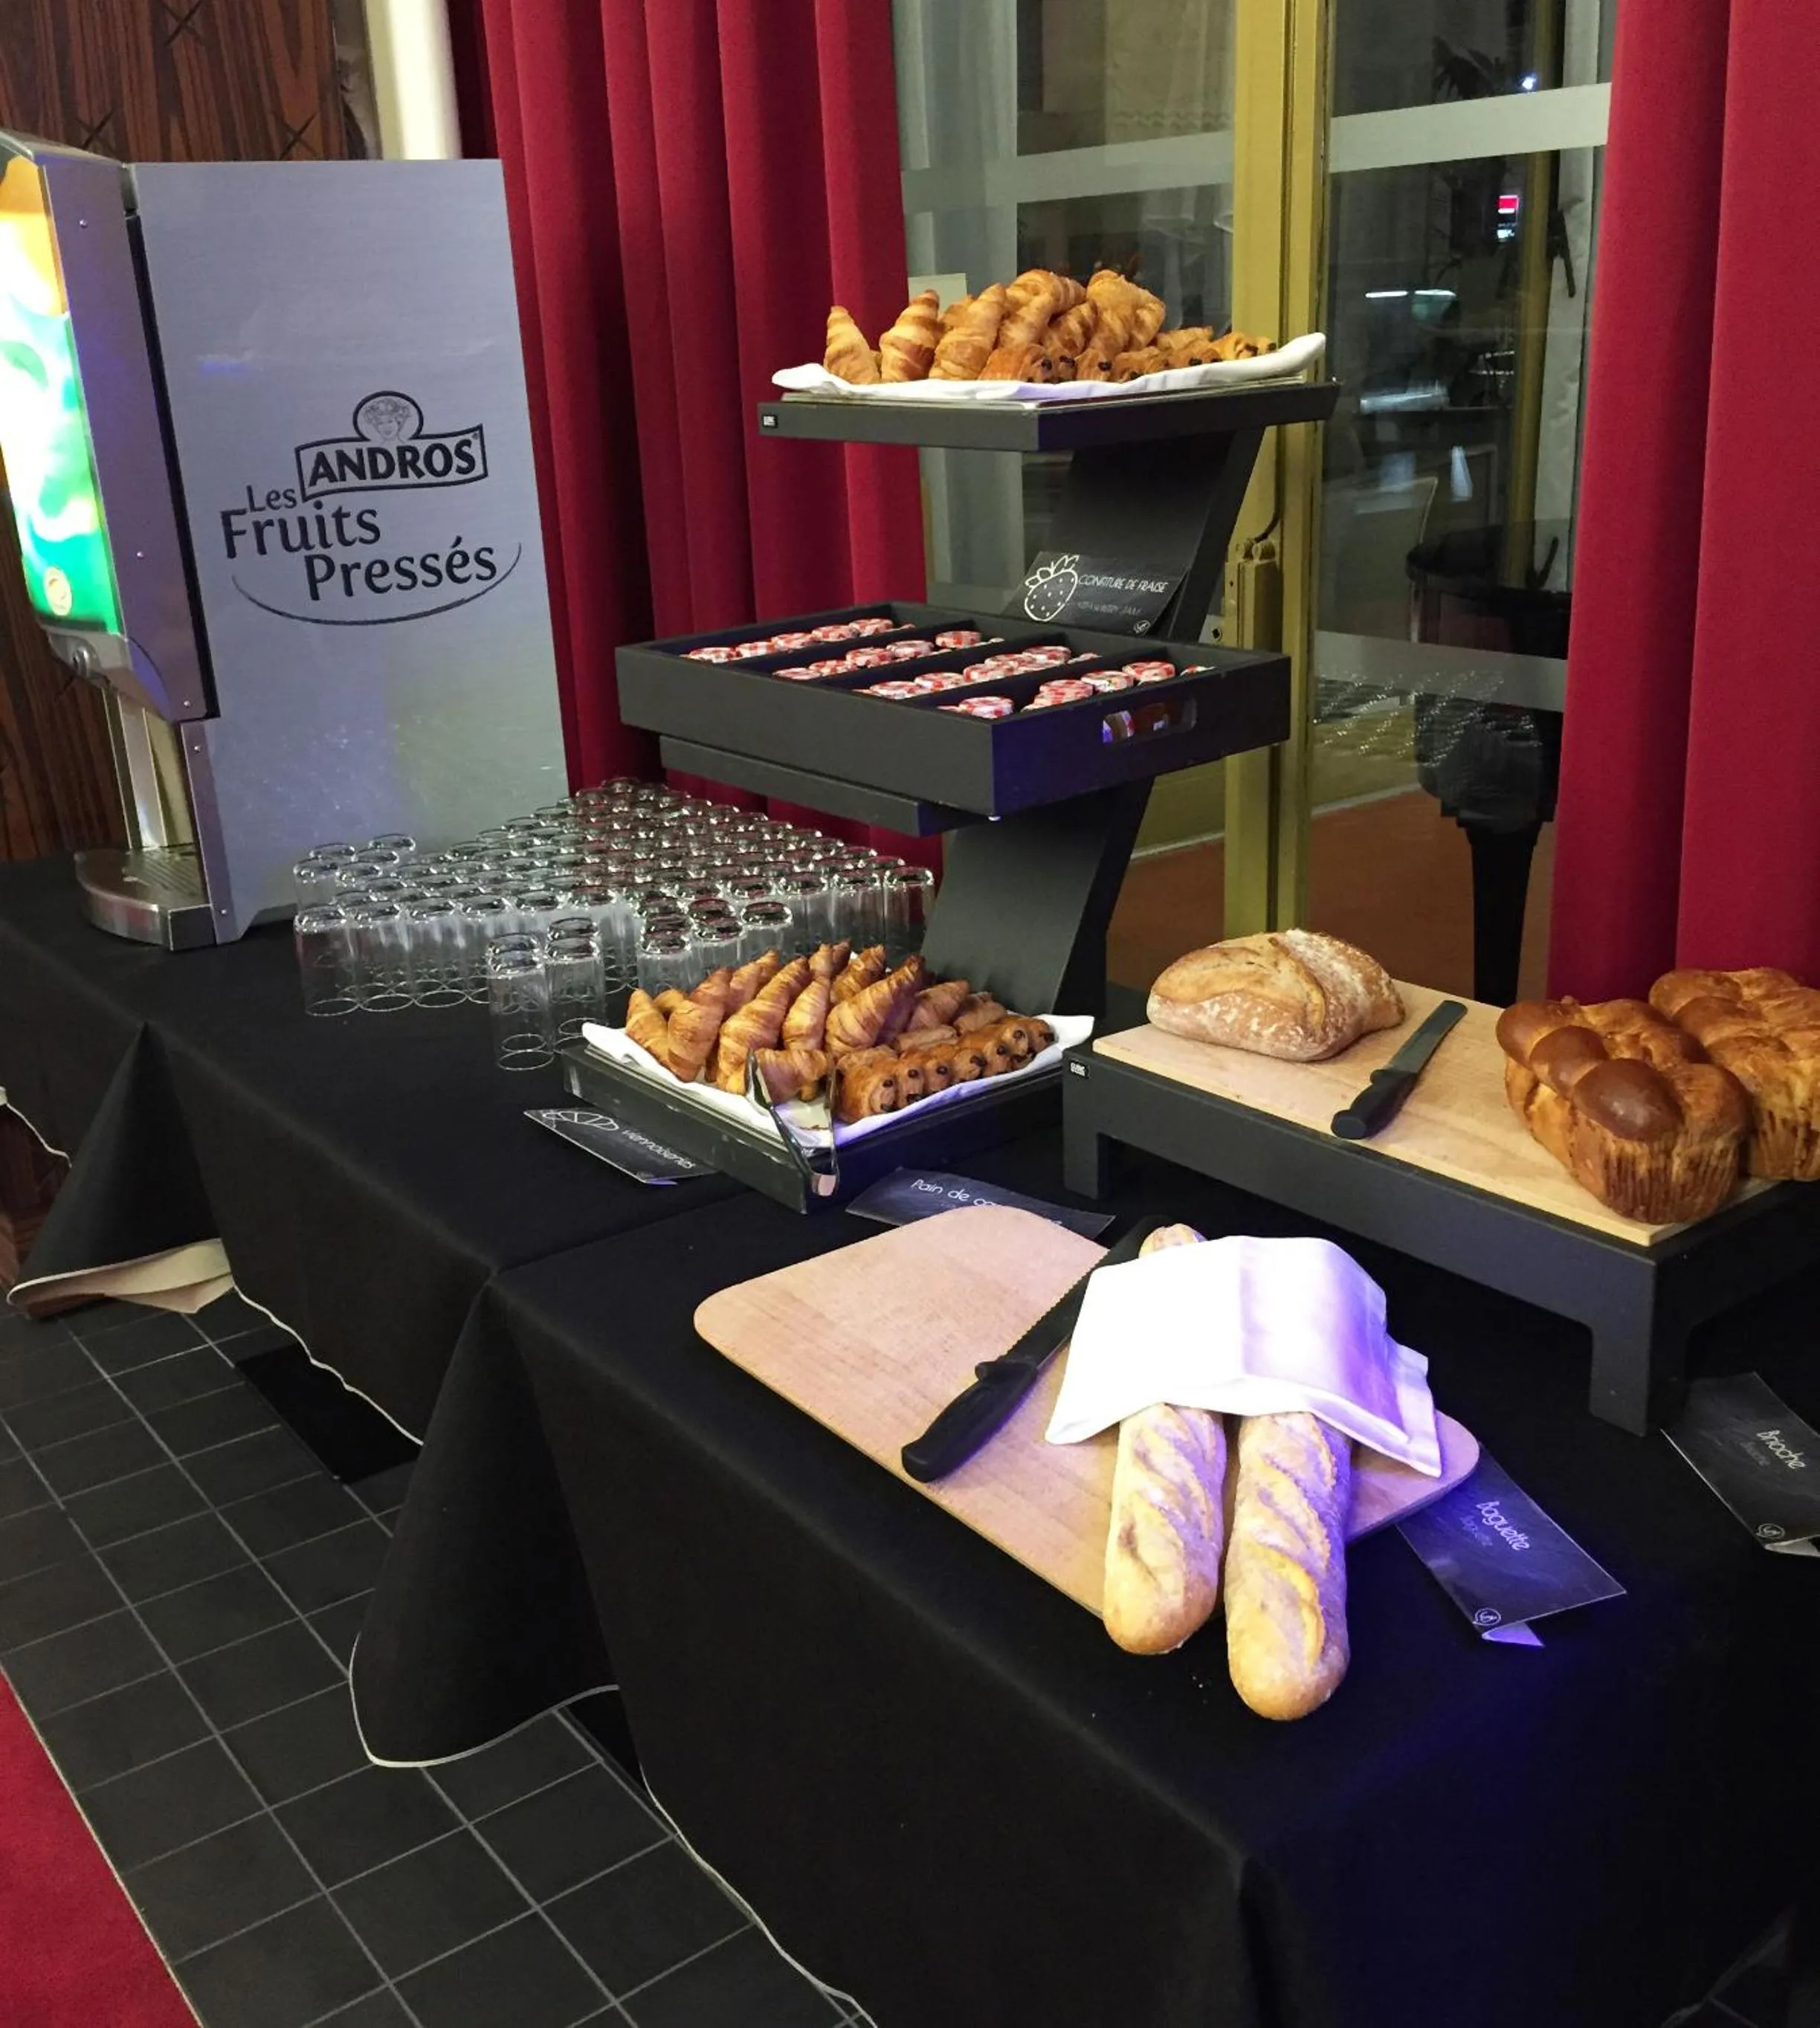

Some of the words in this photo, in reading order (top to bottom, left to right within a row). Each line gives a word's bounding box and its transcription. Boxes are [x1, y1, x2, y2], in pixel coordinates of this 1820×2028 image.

[308, 439, 477, 488] ANDROS
[246, 485, 297, 512] Les
[220, 500, 381, 559] Fruits
[303, 535, 497, 601] Pressés
[911, 1178, 943, 1193] Pain
[947, 1188, 970, 1201] de
